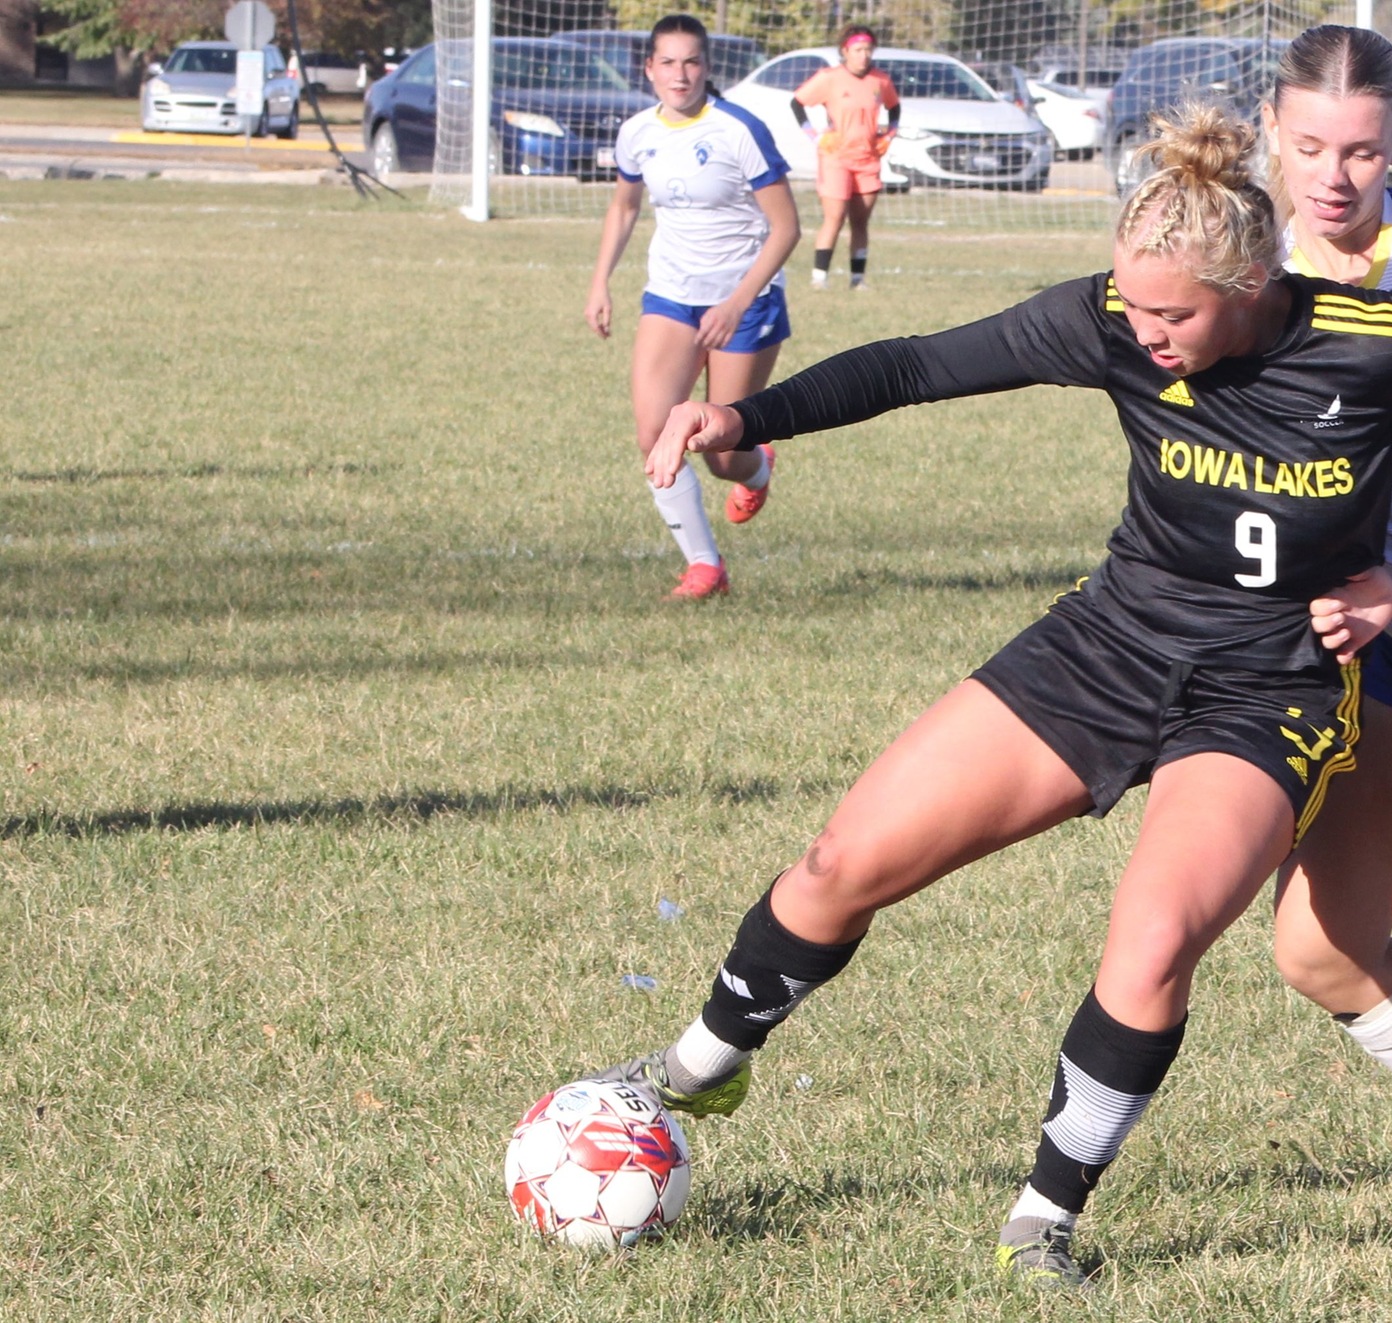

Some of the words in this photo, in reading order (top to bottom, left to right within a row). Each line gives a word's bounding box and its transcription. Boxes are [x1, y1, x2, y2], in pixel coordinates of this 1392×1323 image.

[1159, 391, 1195, 408] adidas
[1160, 438, 1248, 490] IOWA
[1254, 456, 1354, 498] LAKES
[1234, 511, 1276, 588] 9
